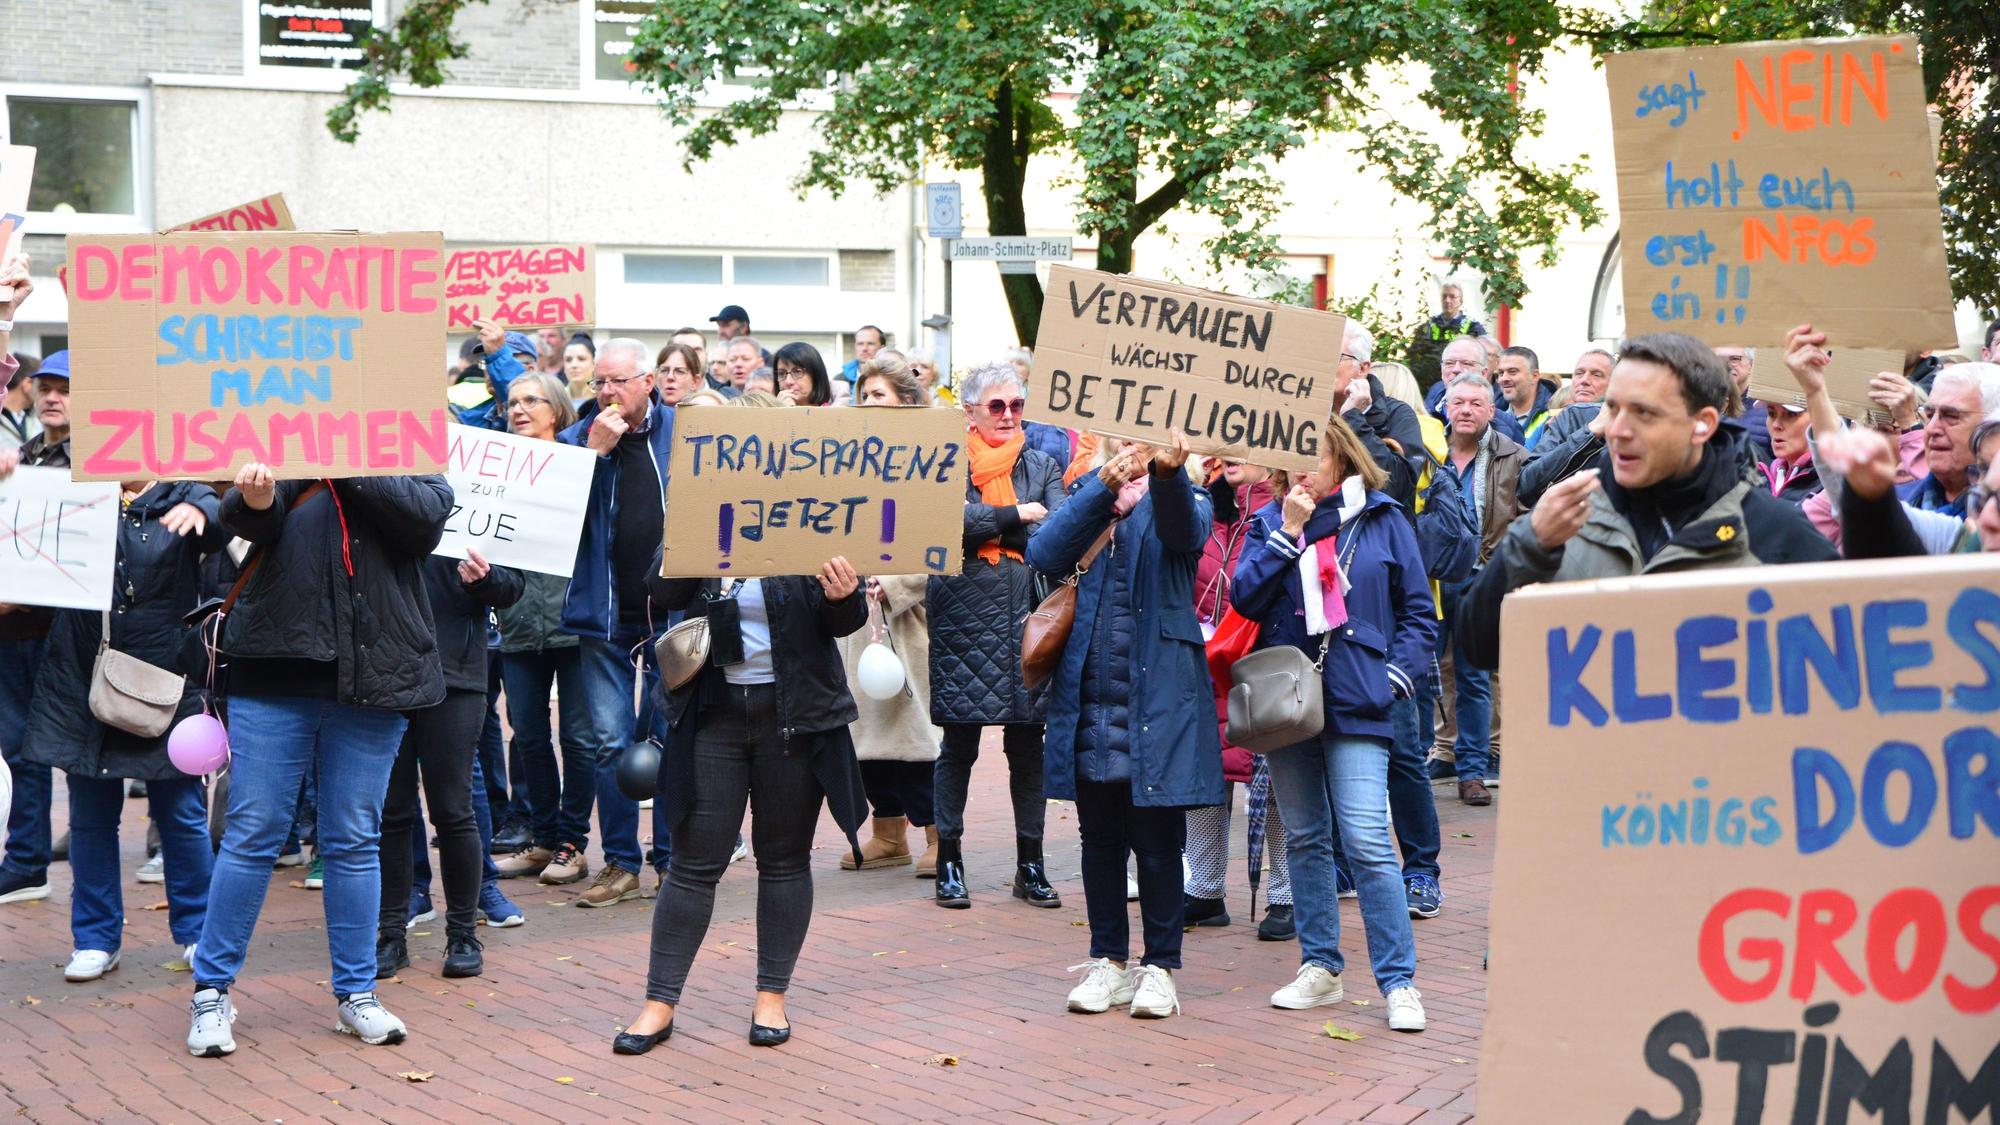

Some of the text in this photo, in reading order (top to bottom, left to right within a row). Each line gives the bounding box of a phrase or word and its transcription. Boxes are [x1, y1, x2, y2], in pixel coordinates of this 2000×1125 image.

[1635, 69, 1706, 128] sagt
[1665, 159, 1855, 213] holt euch
[954, 241, 1067, 257] Johann-Schmitz-Platz
[1645, 211, 1877, 267] erst INFOS
[75, 244, 440, 313] DEMOKRATIE
[156, 314, 363, 365] SCHREIBT
[1069, 280, 1273, 352] VERTRAUEN
[210, 366, 332, 408] MAN
[1111, 342, 1314, 399] WÄCHST DURCH
[1048, 370, 1319, 456] BETEILIGUNG
[83, 409, 448, 475] ZUSAMMEN
[449, 435, 555, 486] NEIN
[684, 434, 959, 483] TRANSPARENZ
[471, 483, 506, 499] ZUR
[0, 495, 95, 568] UE
